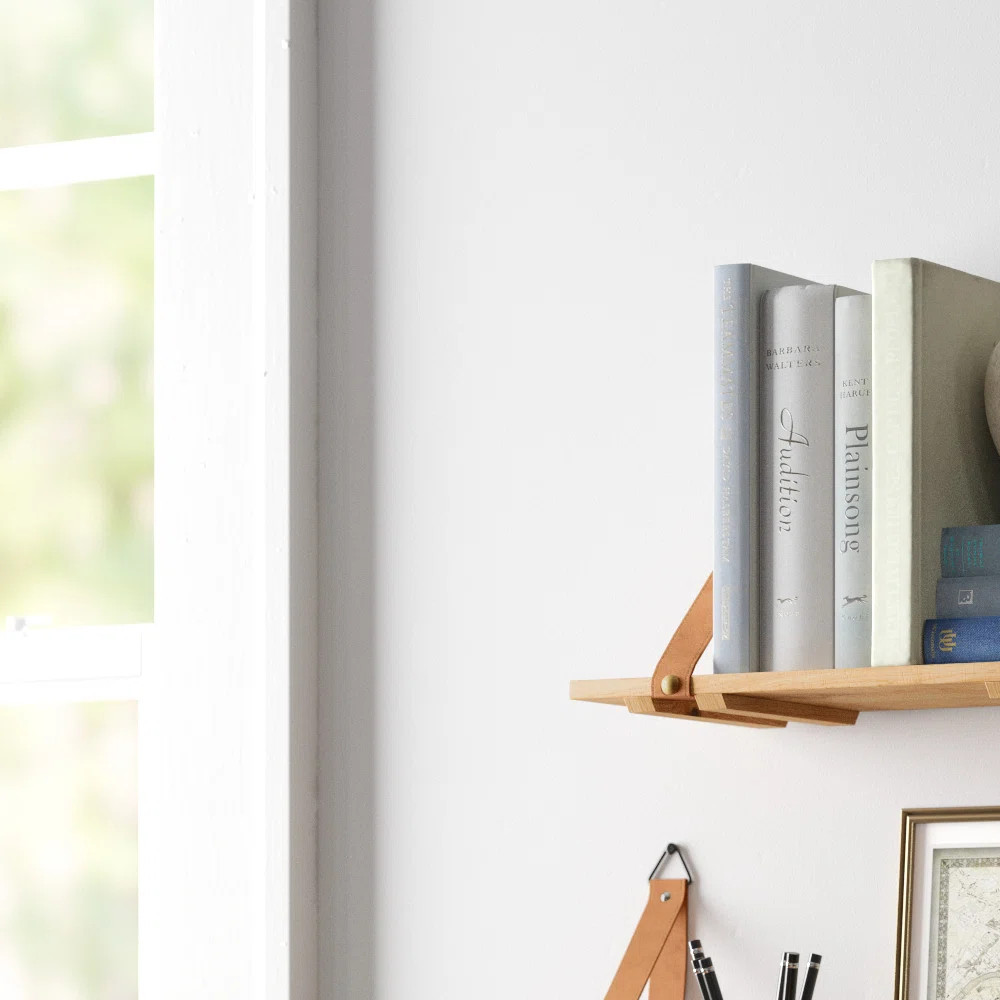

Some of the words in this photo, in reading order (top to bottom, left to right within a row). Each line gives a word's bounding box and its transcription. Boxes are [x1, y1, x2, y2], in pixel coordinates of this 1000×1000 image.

[842, 377, 869, 388] KENT
[777, 407, 810, 533] Audition
[839, 423, 869, 554] Plainsong
